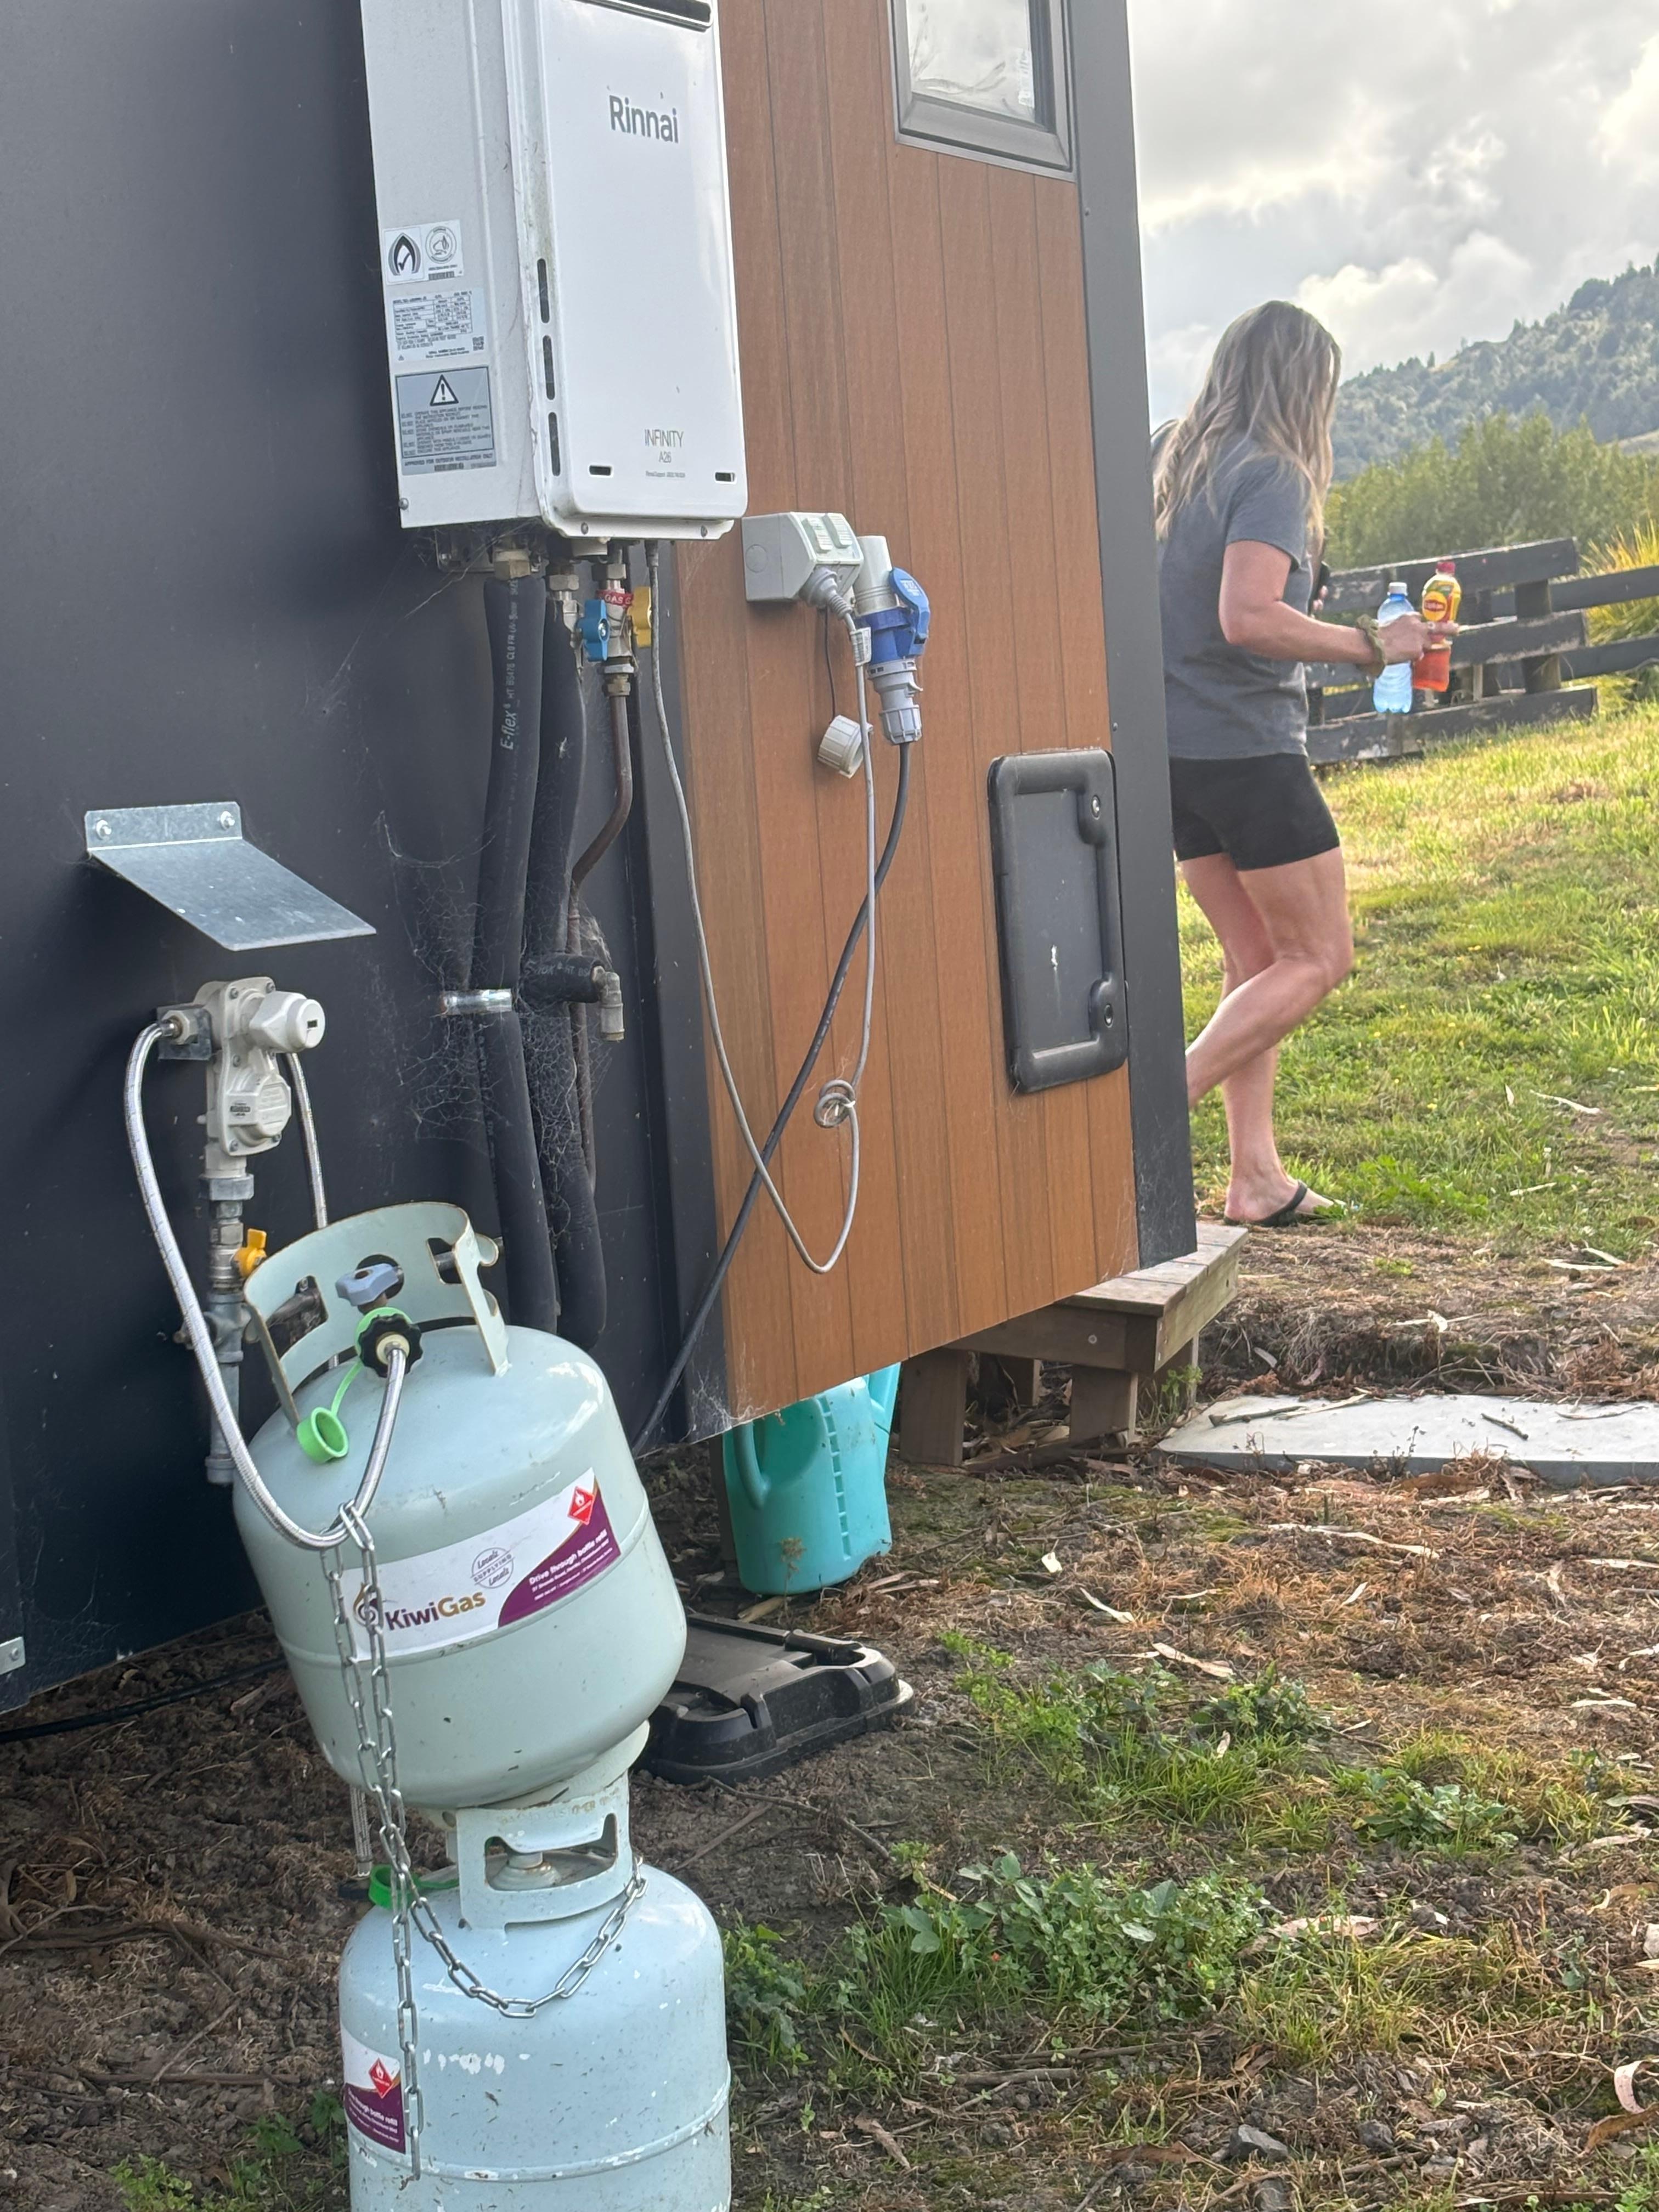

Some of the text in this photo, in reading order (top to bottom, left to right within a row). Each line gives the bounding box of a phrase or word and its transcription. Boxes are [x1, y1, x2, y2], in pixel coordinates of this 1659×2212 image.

[609, 95, 678, 143] Rinnai
[644, 429, 684, 448] INFINITY
[659, 451, 672, 463] A26
[605, 594, 623, 604] GAS
[473, 1554, 512, 1582] SUPPLYING
[529, 1571, 549, 1585] Drive
[550, 1554, 577, 1573] through
[577, 1540, 595, 1557] bottle
[595, 1528, 607, 1543] refill
[385, 1592, 486, 1630] KiwiGas
